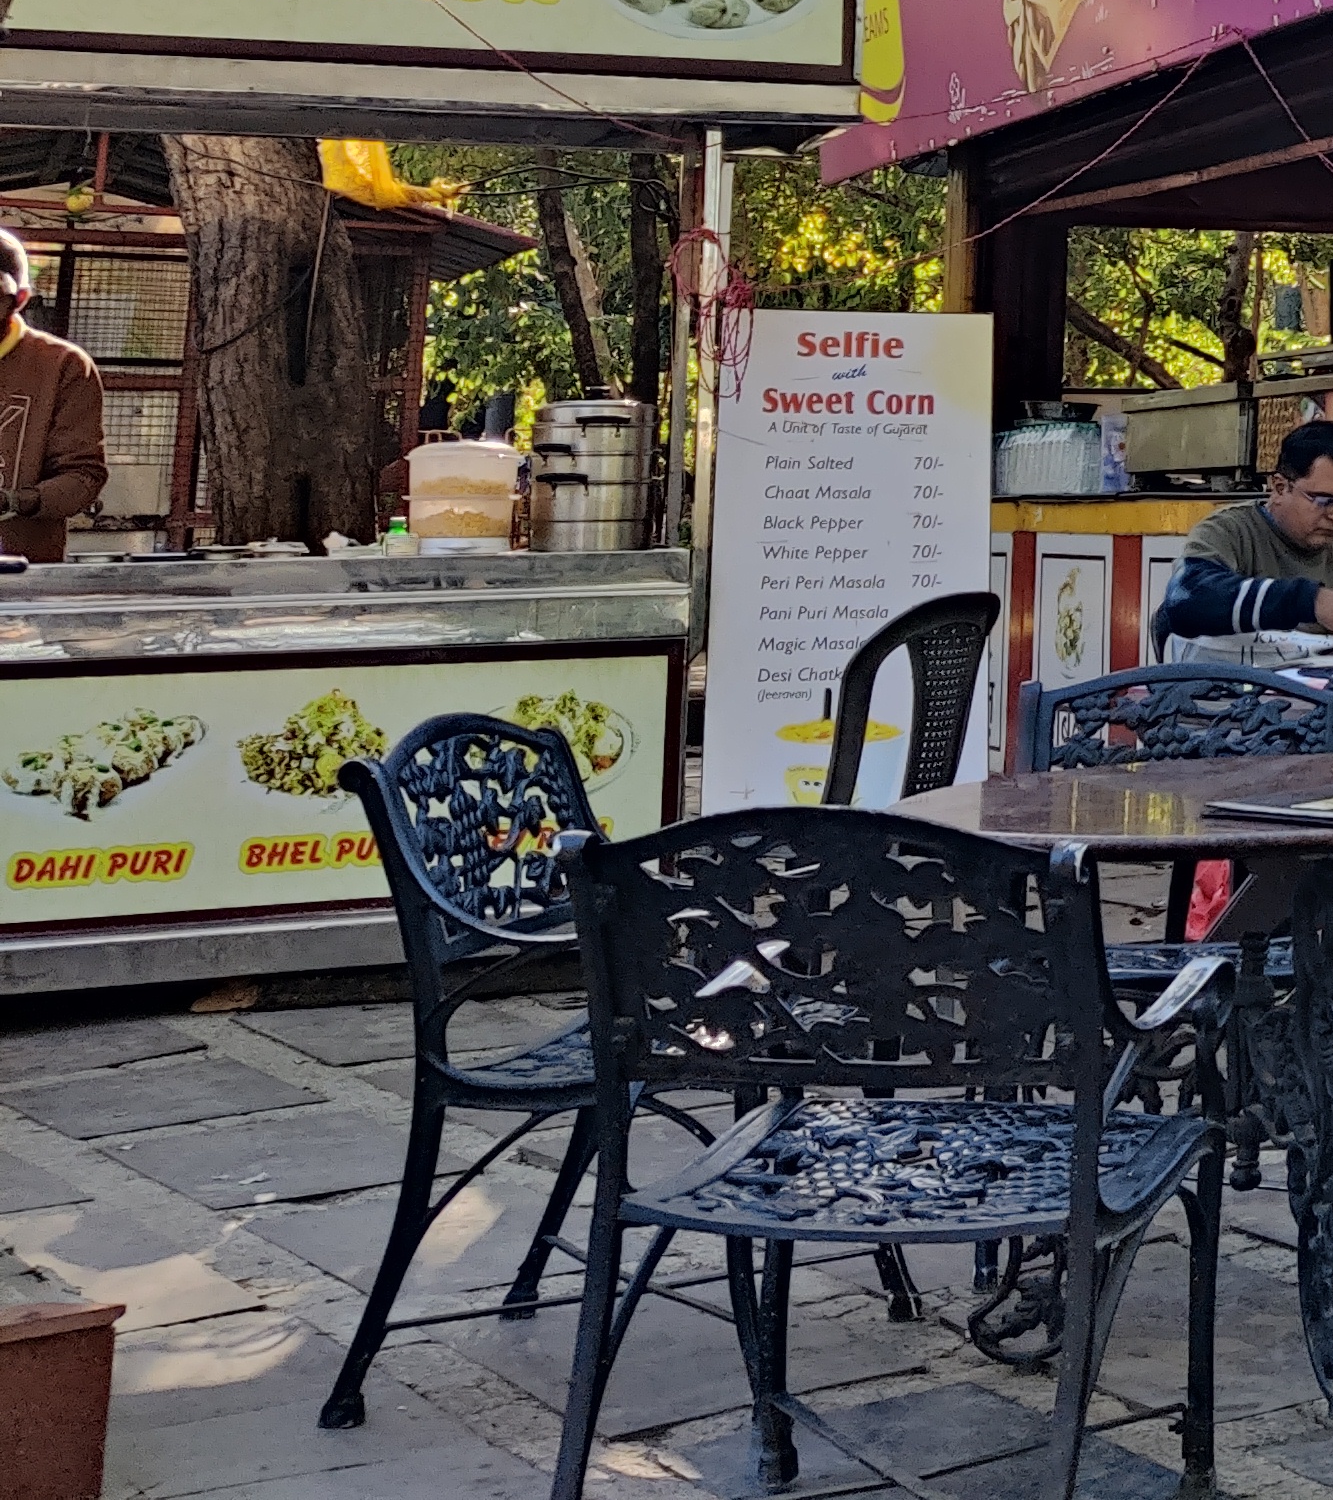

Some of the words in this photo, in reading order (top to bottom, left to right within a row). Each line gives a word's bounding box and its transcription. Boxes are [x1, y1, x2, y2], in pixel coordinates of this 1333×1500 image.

[797, 331, 904, 359] Selfie
[832, 364, 867, 380] with
[762, 388, 854, 414] Sweet
[867, 390, 934, 415] Corn
[768, 422, 777, 433] A
[783, 422, 808, 433] Unit
[812, 422, 827, 436] of
[832, 423, 861, 435] Taste
[867, 423, 880, 436] of
[883, 423, 928, 437] Gujarat
[765, 456, 800, 470] Plain
[808, 457, 853, 470] Salted
[914, 457, 943, 471] 70/-
[765, 486, 810, 499] Chaat
[816, 486, 871, 499] Masala
[913, 486, 943, 499] 70/-
[763, 515, 804, 530] Black
[810, 516, 863, 533] Pepper
[912, 515, 943, 529] 70/-
[763, 545, 809, 560] White
[815, 546, 869, 563] Pepper
[912, 545, 942, 559] 70/-
[761, 576, 790, 590] Peri
[795, 576, 824, 589] Peri
[829, 575, 885, 589] Masala
[912, 574, 942, 588] 70/-
[759, 606, 792, 620] Pani
[797, 606, 827, 620] Puri
[833, 606, 889, 620] Masala
[758, 637, 805, 656] Magic
[758, 668, 791, 683] Desi
[246, 840, 323, 868] BHEL
[335, 836, 383, 862] PU
[14, 855, 93, 883] DAHI
[107, 849, 189, 875] PURI
